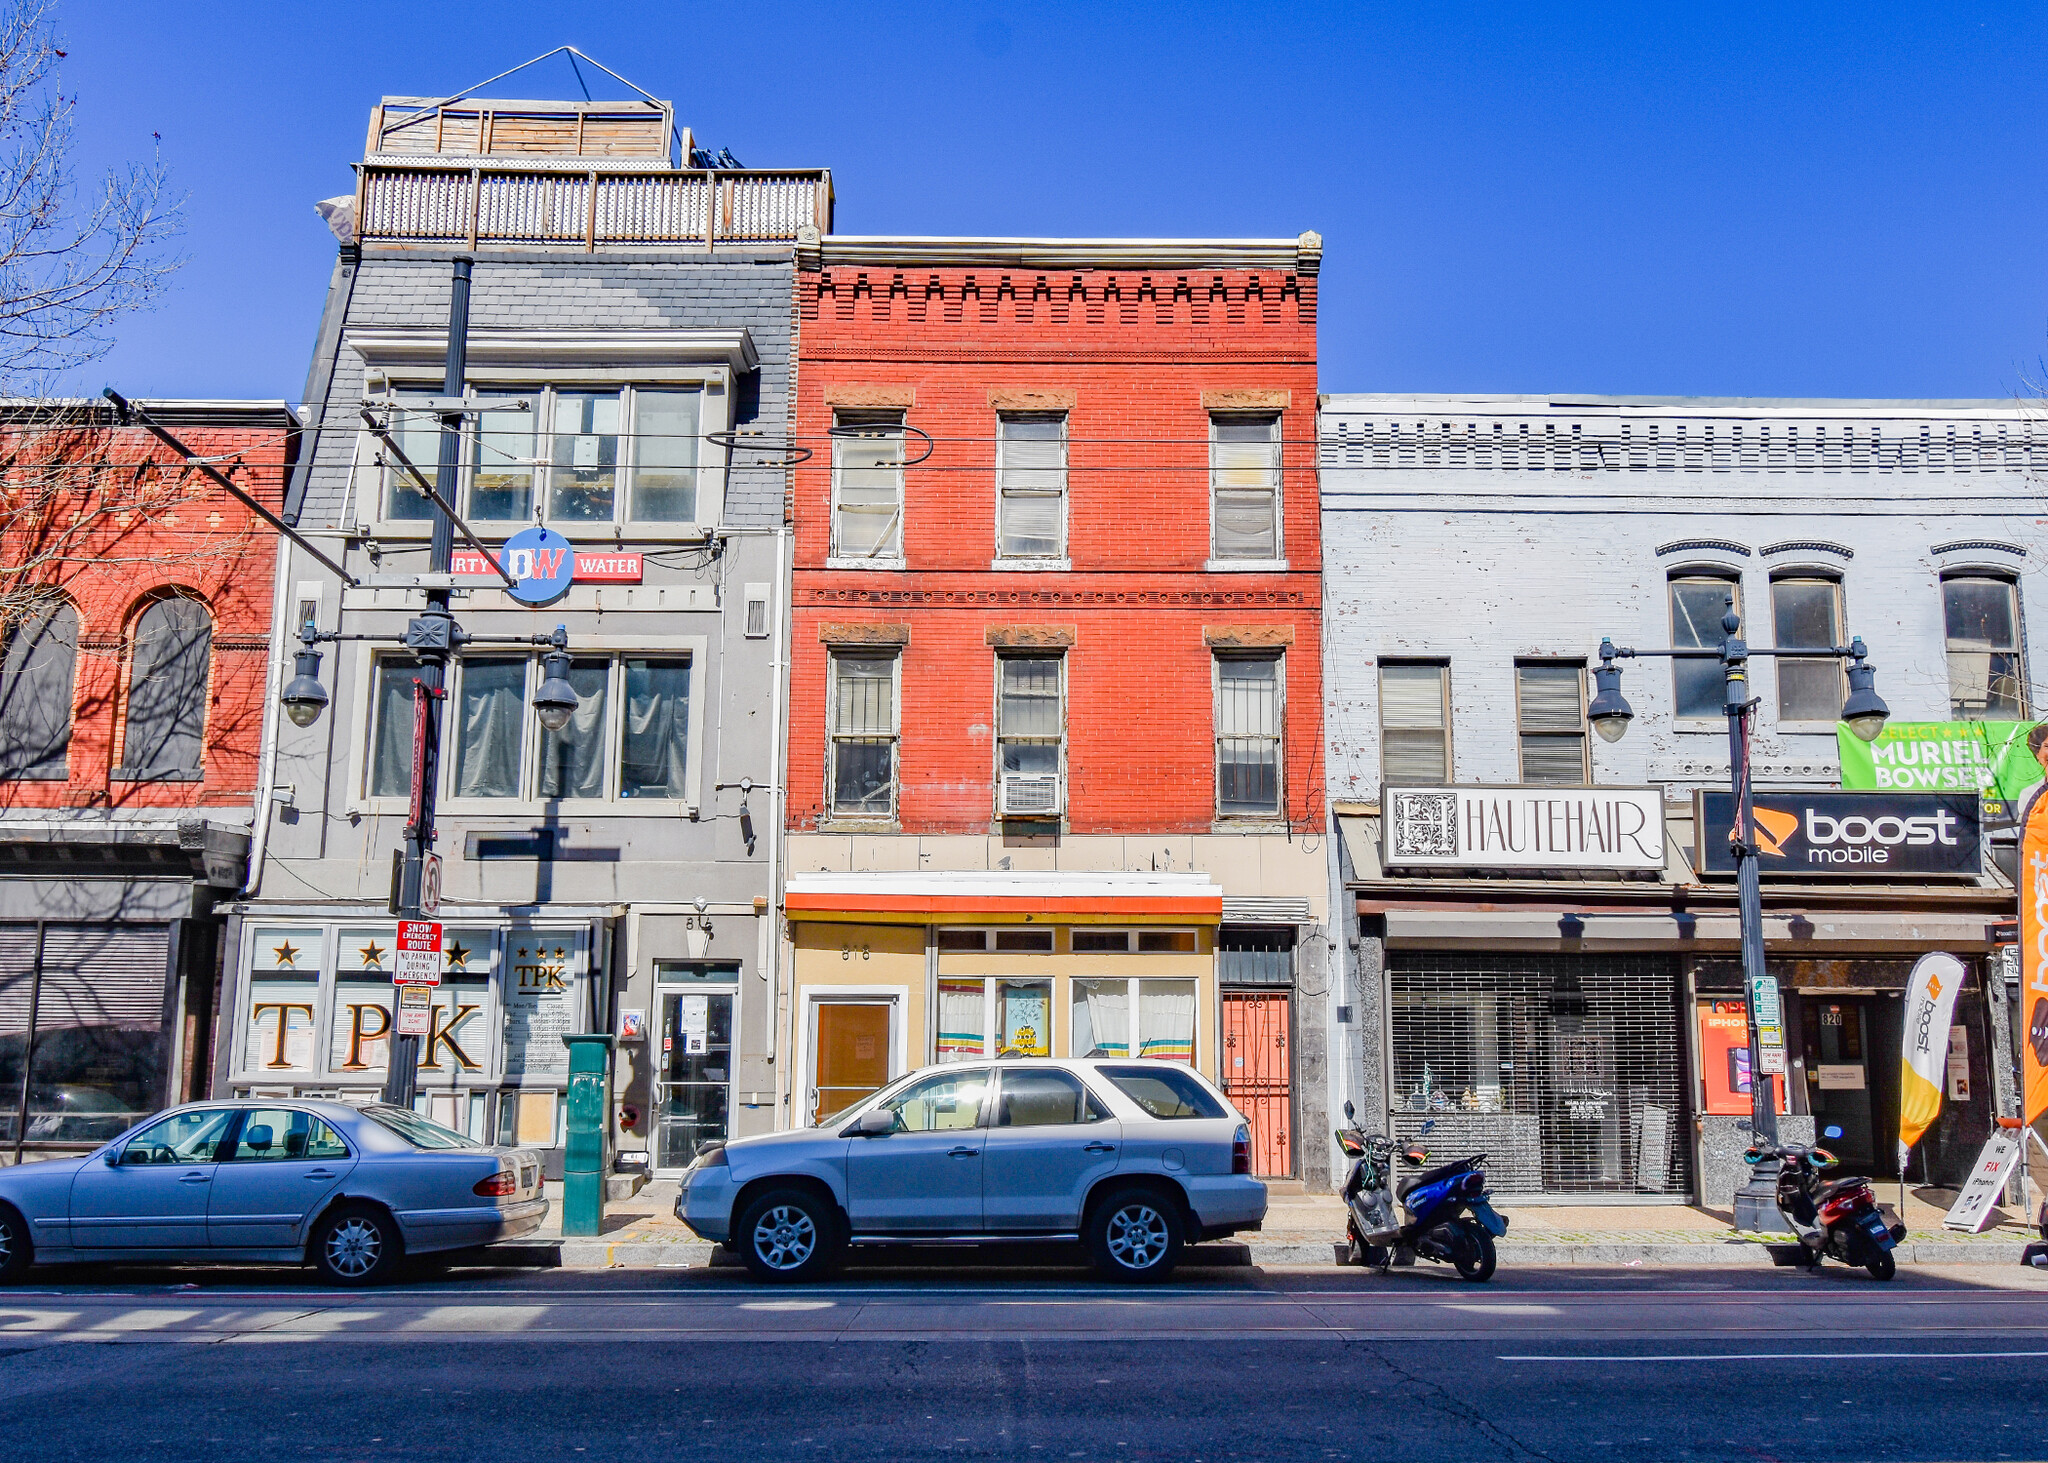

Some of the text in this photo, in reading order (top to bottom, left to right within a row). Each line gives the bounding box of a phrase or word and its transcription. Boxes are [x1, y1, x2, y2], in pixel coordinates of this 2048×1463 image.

[451, 557, 488, 573] IRTY
[579, 557, 638, 574] WATER
[1870, 740, 1990, 766] MURIEL
[1875, 766, 1996, 788] BOWSER
[1805, 808, 1958, 846] boost
[1808, 846, 1889, 863] mobile
[407, 923, 433, 933] SNOW
[402, 932, 437, 941] EMERGENCY
[407, 940, 432, 951] ROUTE
[401, 951, 437, 962] NO PARKING
[406, 961, 430, 971] DURING
[399, 970, 437, 980] EMERGENCY
[514, 965, 566, 988] TPK
[1708, 1018, 1746, 1027] iPHON
[1822, 1014, 1841, 1025] 820
[1917, 1000, 1937, 1054] boost
[1995, 1145, 2006, 1154] WE
[1983, 1161, 2000, 1172] FIX
